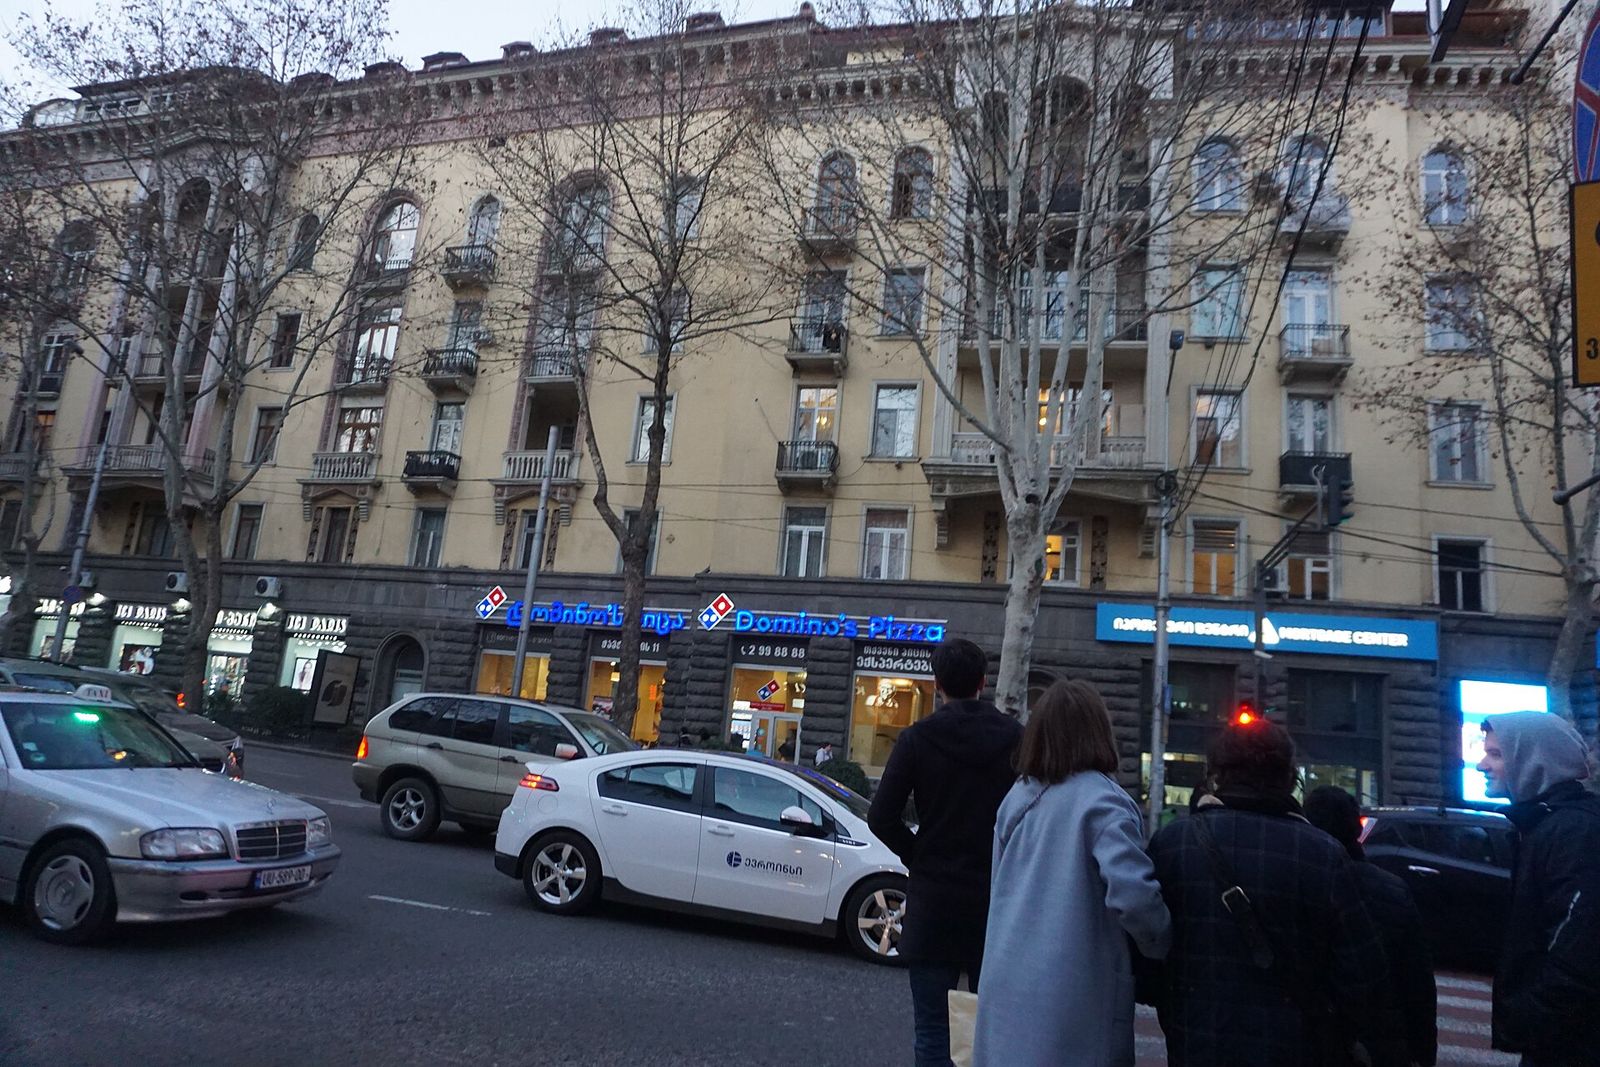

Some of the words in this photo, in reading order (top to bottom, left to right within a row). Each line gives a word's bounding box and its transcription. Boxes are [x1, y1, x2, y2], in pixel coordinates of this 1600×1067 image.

[641, 612, 686, 636] იცა
[735, 610, 859, 638] Domino's
[868, 615, 947, 643] Pizza
[1353, 631, 1408, 647] CENTER
[748, 644, 756, 656] 2
[758, 645, 771, 657] 99
[774, 646, 788, 657] 88
[791, 647, 805, 659] 88
